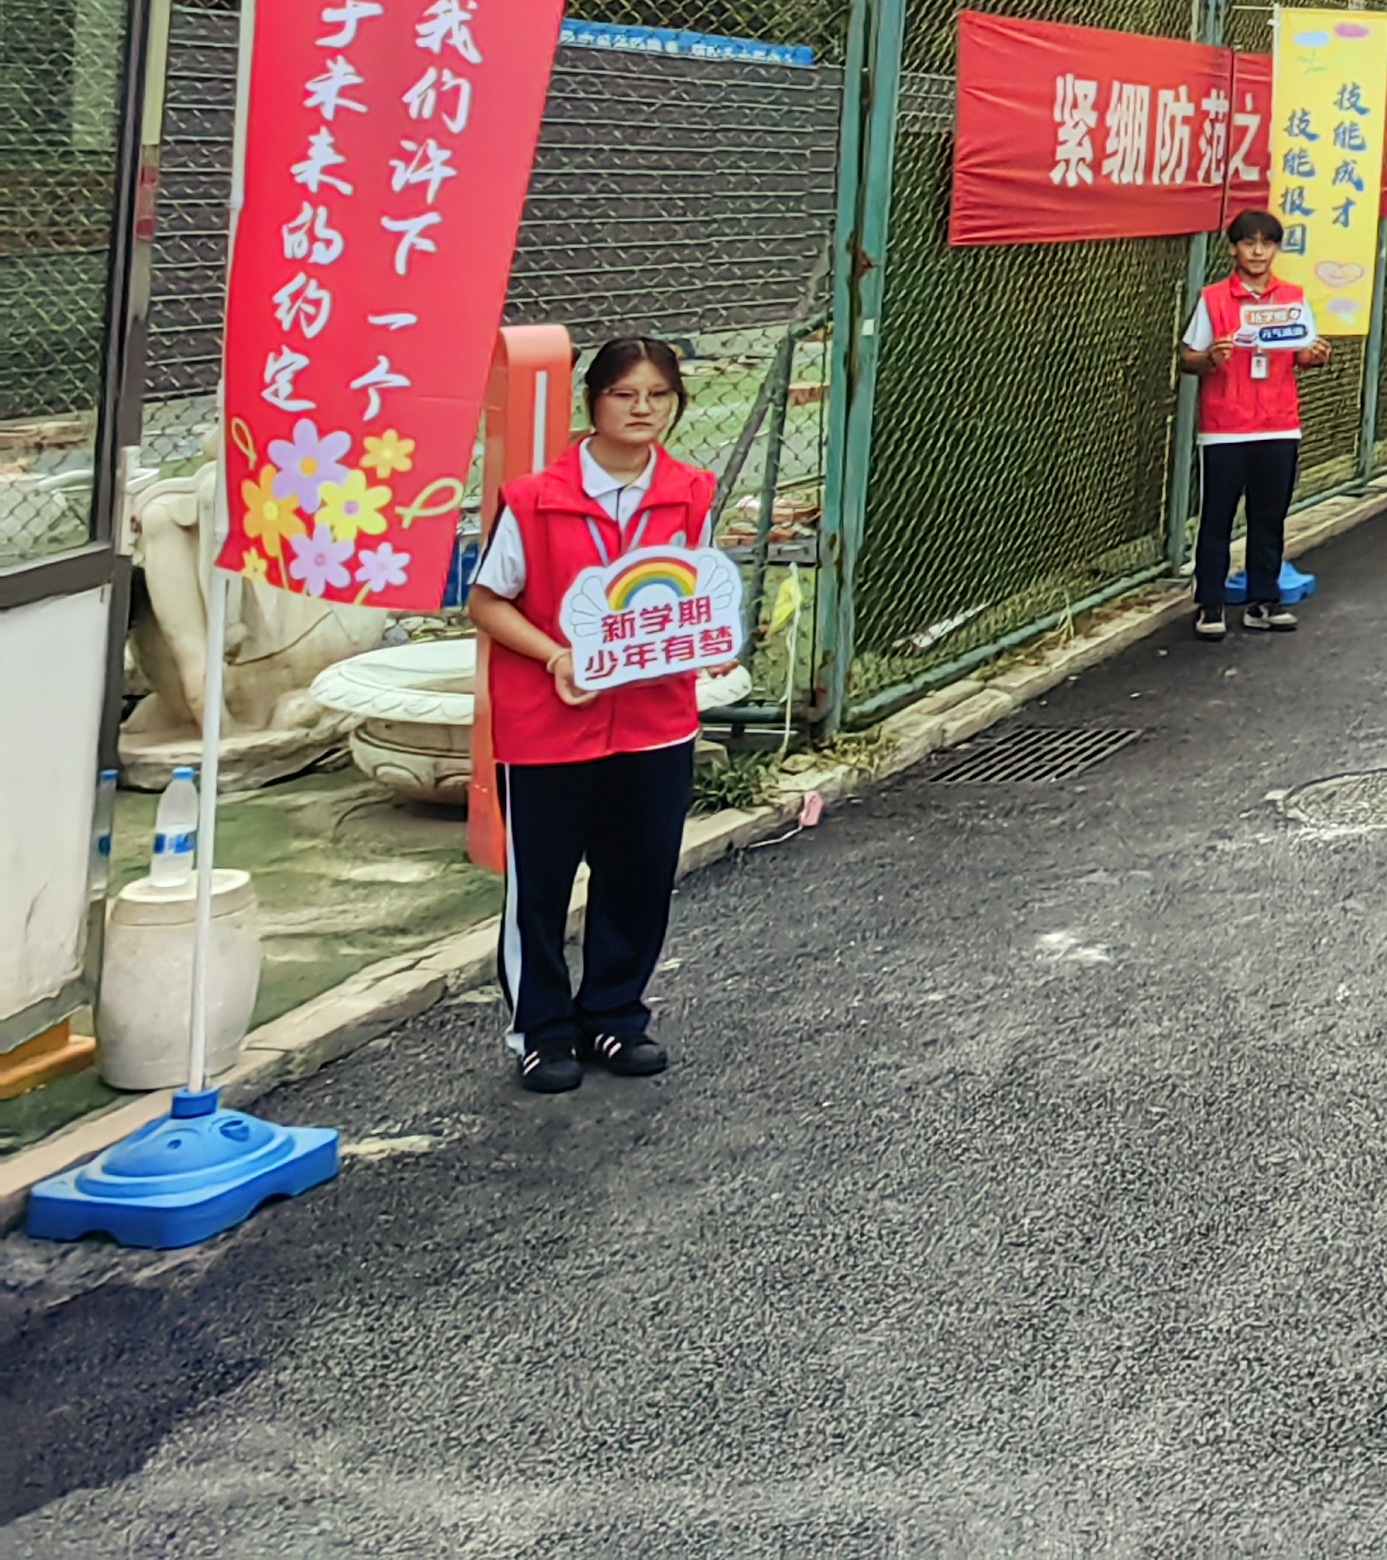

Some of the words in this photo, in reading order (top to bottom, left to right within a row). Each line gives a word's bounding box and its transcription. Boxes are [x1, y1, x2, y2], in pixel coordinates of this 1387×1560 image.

[1049, 73, 1273, 187] 紧绷防范之
[1279, 108, 1319, 256] 技能报国
[1332, 82, 1370, 228] 技能成才
[585, 626, 733, 681] 少年有梦
[601, 596, 712, 644] 新学期
